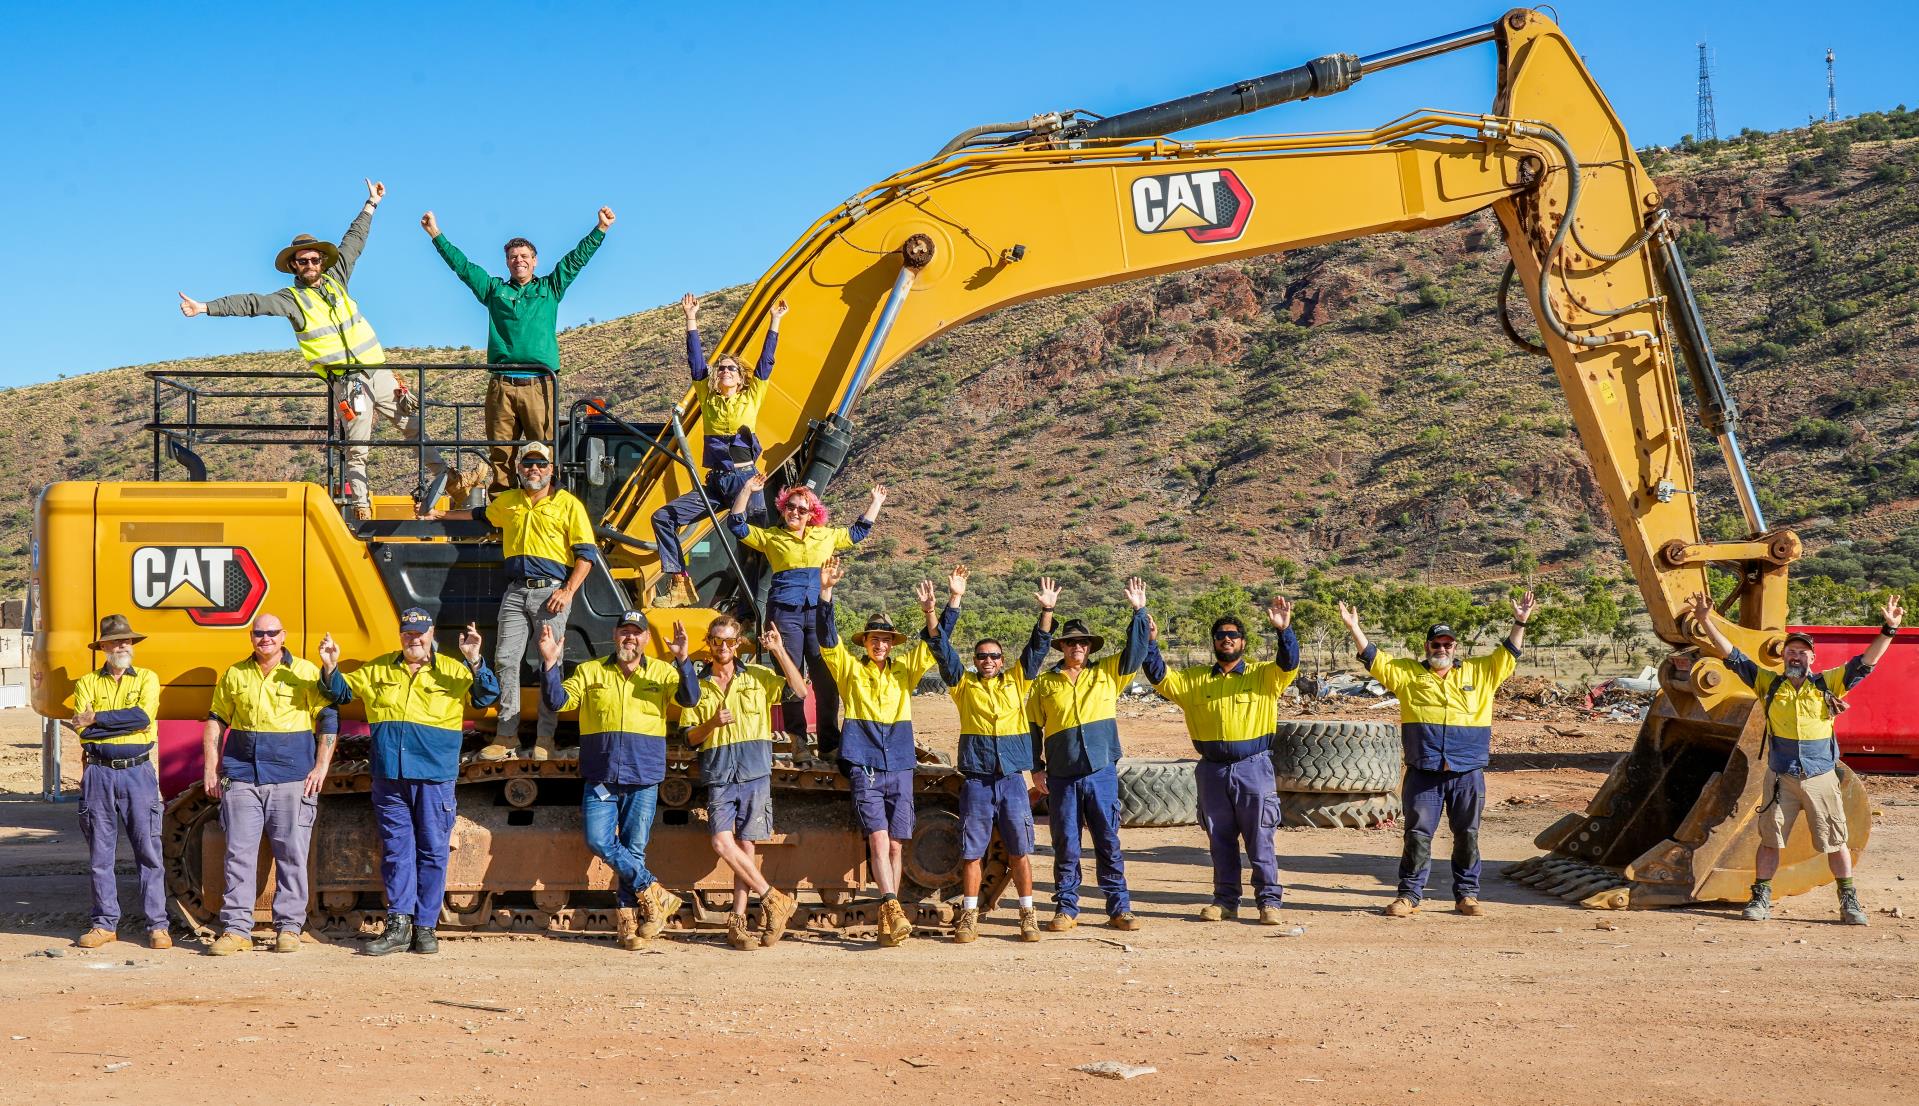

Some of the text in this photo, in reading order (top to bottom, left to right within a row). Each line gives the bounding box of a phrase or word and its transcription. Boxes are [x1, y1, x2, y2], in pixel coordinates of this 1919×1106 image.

[1132, 170, 1220, 232] CAT
[133, 547, 233, 608] CAT
[625, 611, 642, 621] CAT
